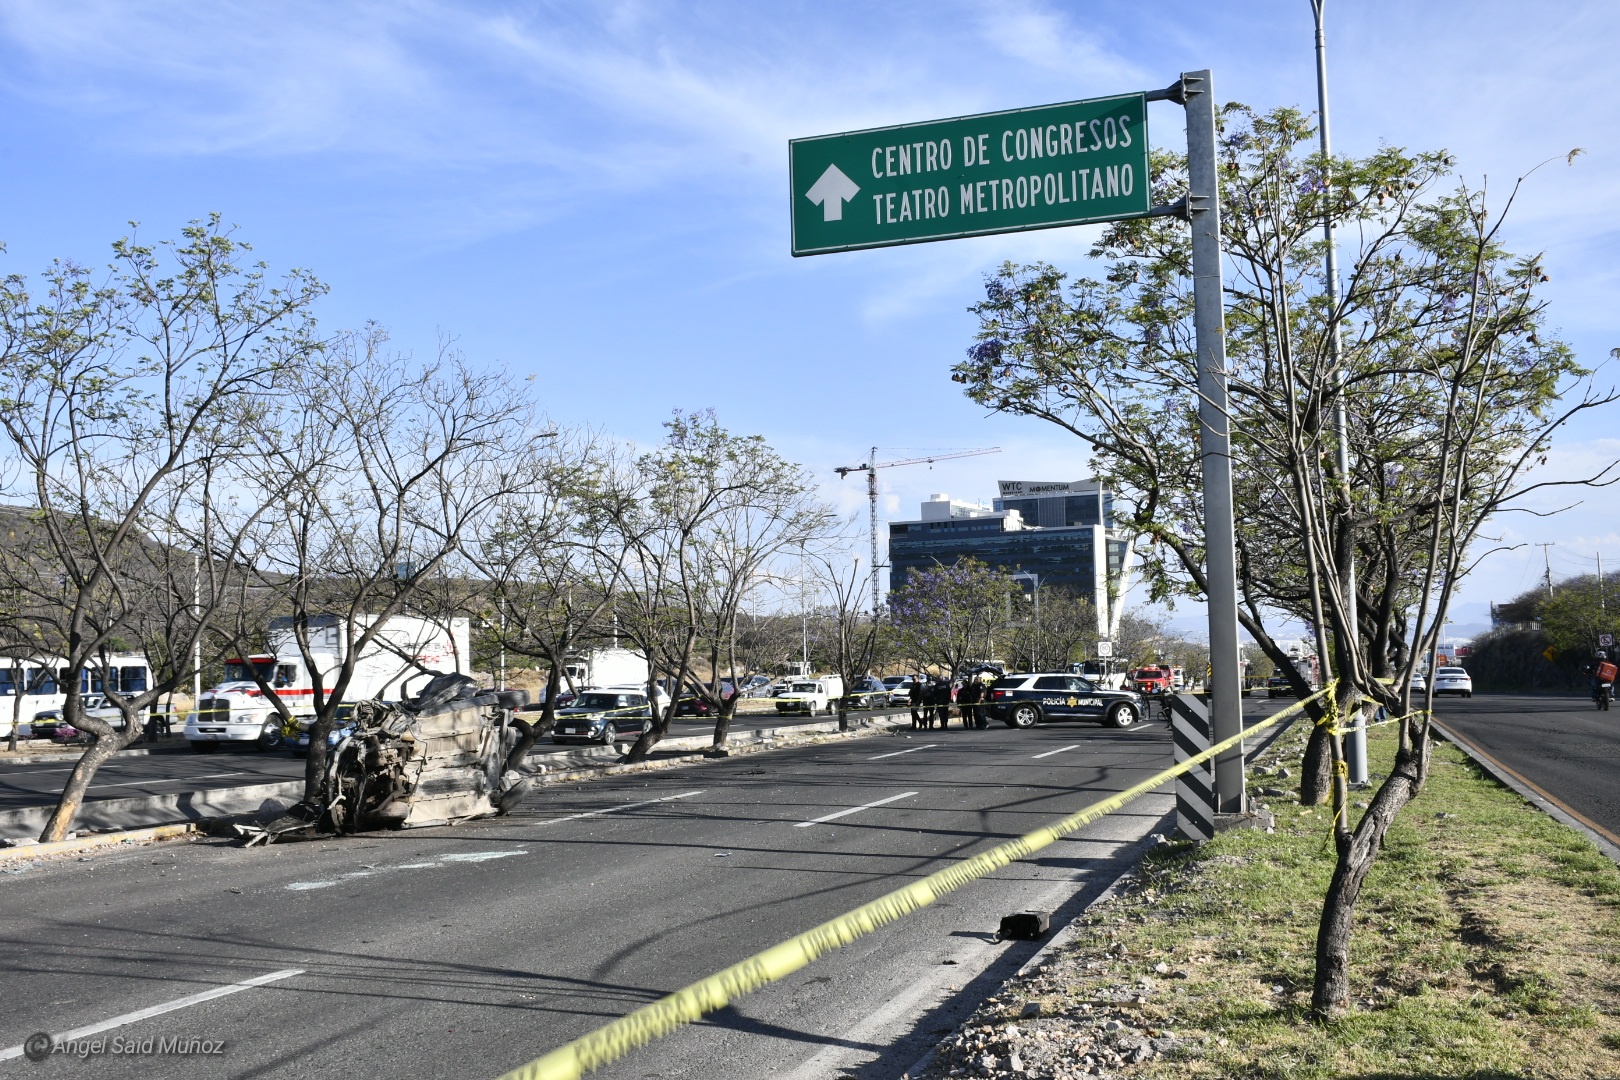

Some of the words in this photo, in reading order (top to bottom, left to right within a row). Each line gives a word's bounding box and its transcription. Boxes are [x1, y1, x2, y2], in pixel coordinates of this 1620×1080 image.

[872, 138, 952, 179] CENTRO
[963, 133, 990, 168] DE
[1001, 114, 1132, 163] CONGRESOS
[873, 186, 949, 225] TEATRO
[960, 163, 1134, 215] METROPOLITANO
[1002, 482, 1022, 491] WTC
[1043, 697, 1065, 706] POLICÍA
